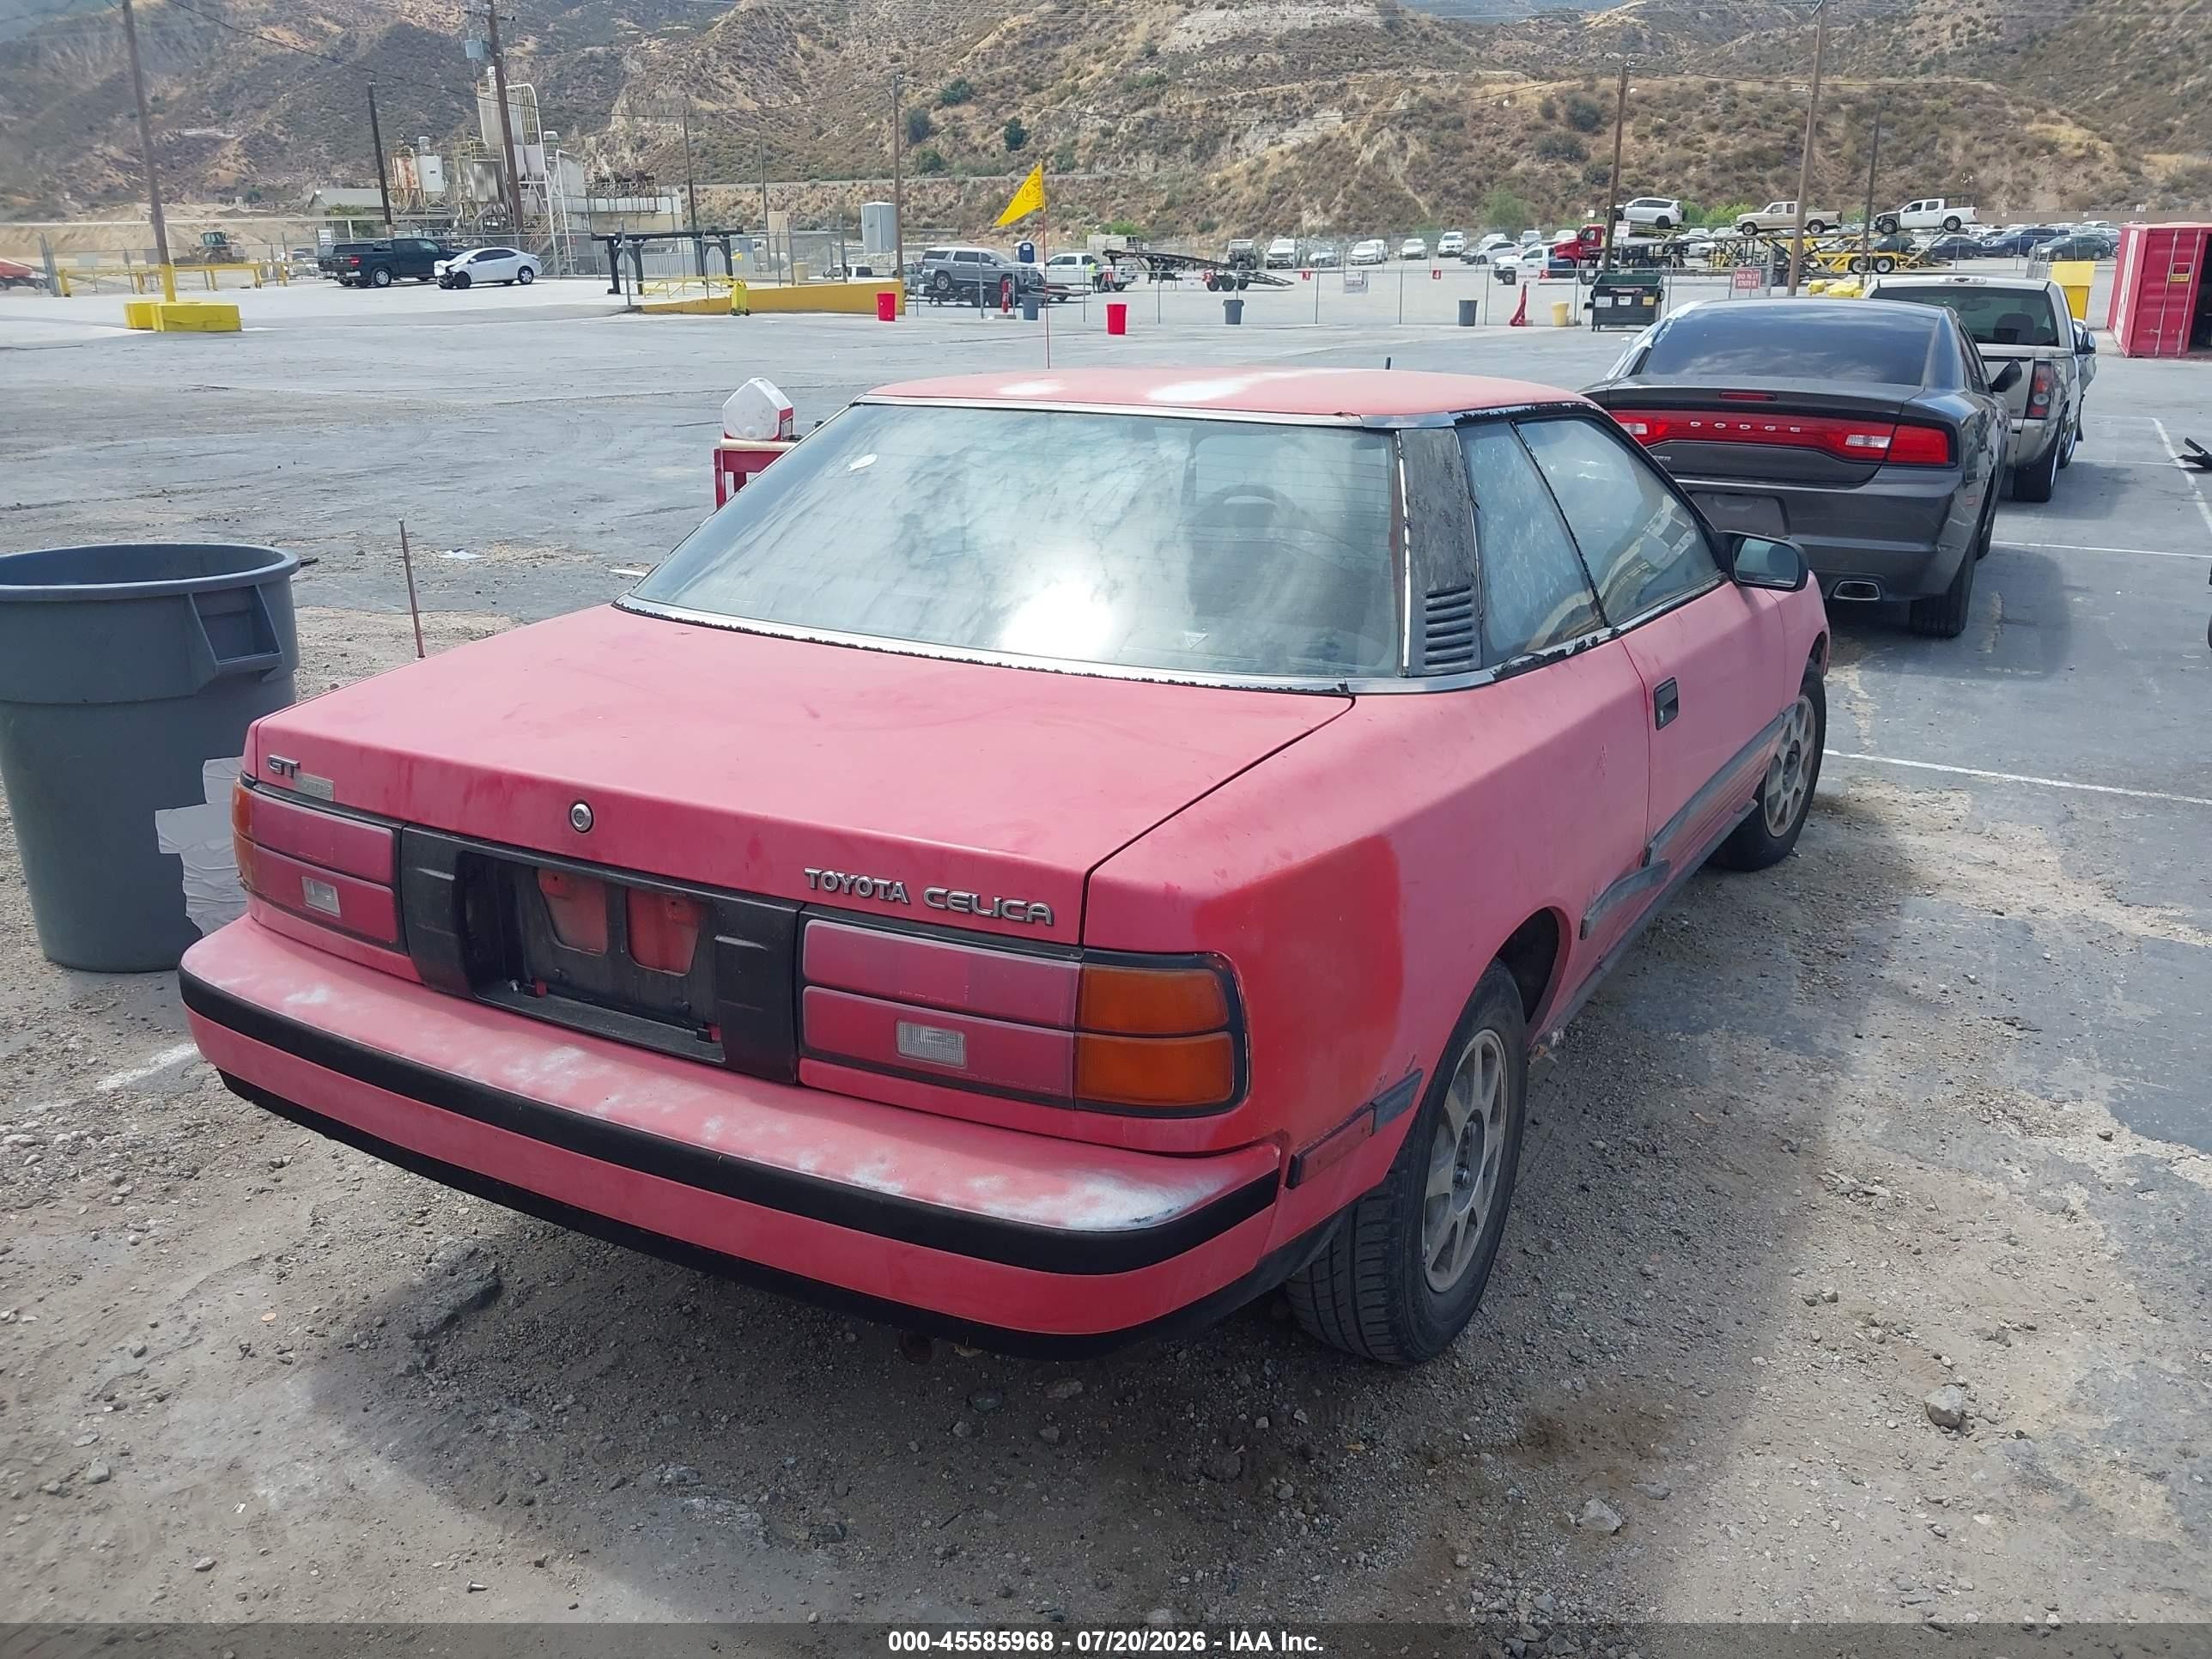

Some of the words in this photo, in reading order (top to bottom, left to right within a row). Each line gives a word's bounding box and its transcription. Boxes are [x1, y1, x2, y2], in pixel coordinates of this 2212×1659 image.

[1690, 421, 1801, 433] DODGE
[267, 755, 301, 778] GT
[804, 866, 910, 904] TOYOTA
[923, 886, 1054, 927] CELICA
